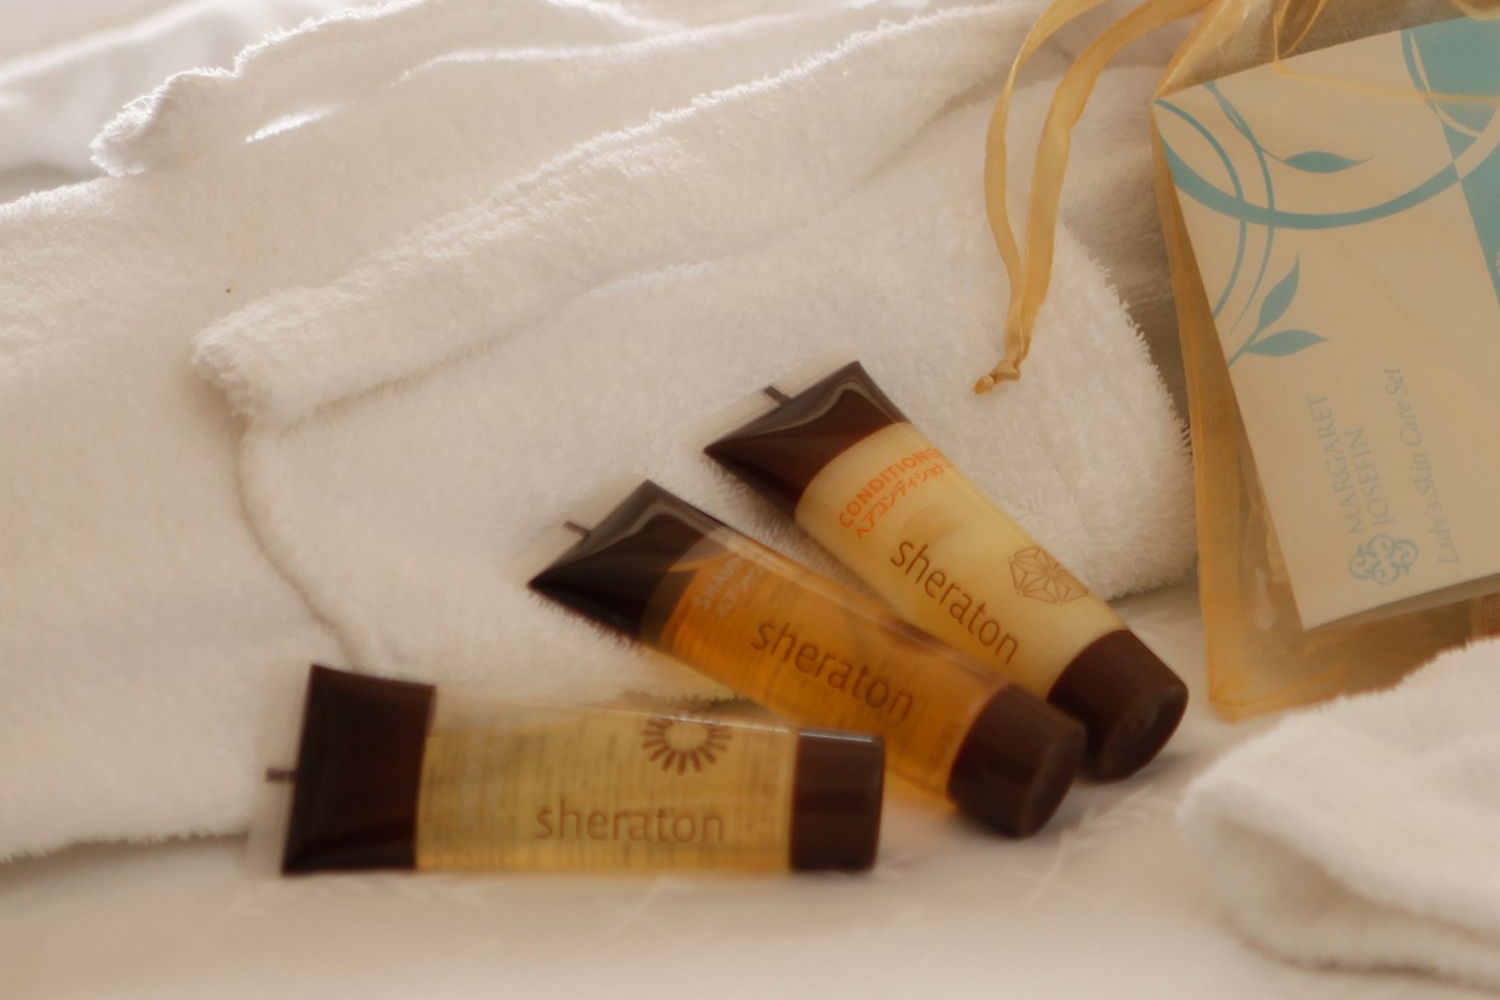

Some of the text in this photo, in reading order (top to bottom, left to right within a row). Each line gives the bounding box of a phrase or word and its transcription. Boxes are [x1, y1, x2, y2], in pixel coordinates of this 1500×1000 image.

[1307, 395, 1365, 535] MARGARET
[1344, 427, 1396, 526] JOSEFIN
[890, 540, 1019, 665] sheraton
[750, 618, 914, 722] sheraton
[535, 795, 724, 843] sheraton
